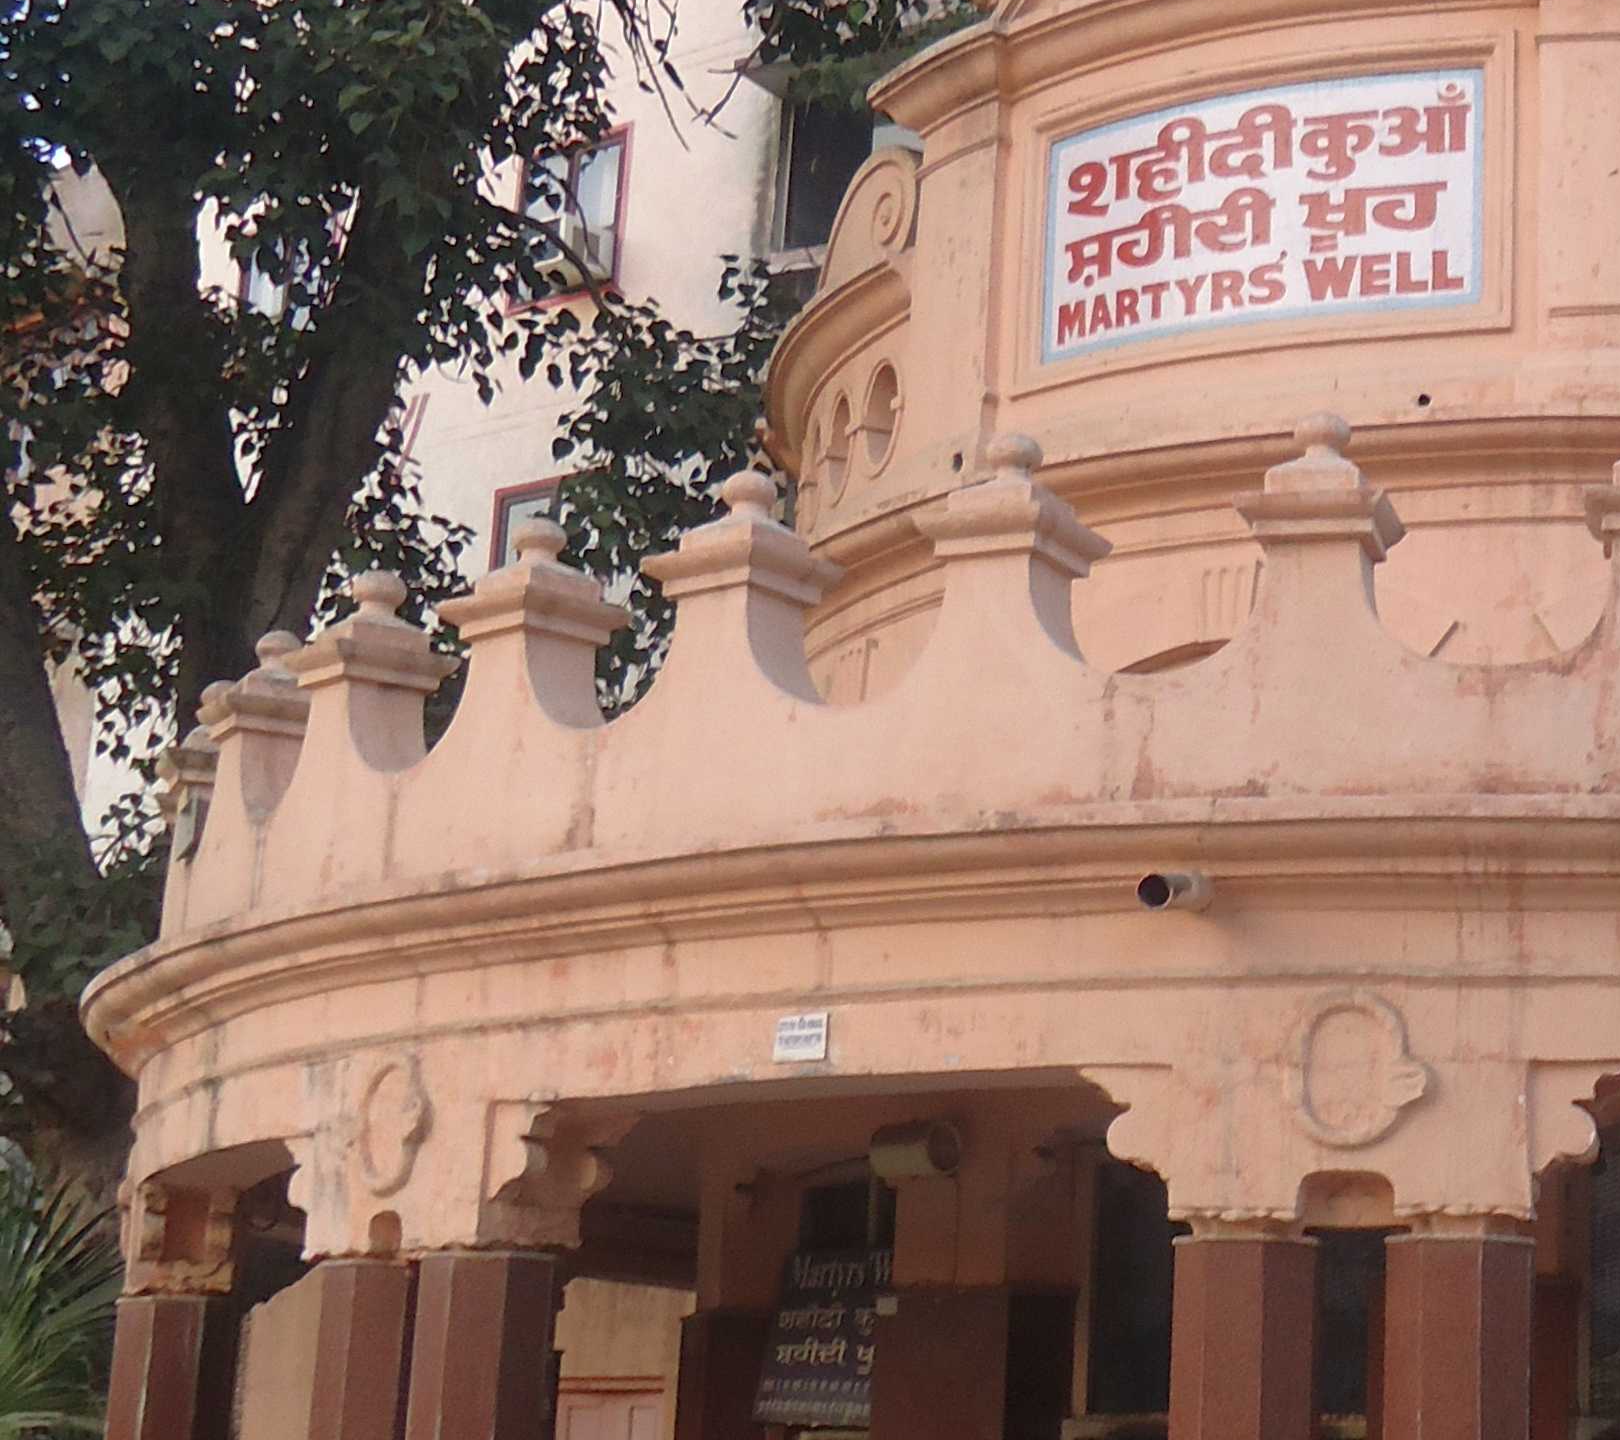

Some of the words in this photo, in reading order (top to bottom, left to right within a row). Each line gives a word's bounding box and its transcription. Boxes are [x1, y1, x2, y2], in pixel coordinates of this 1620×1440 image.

[1067, 103, 1297, 218] शहीदी
[1064, 186, 1276, 288] ਸ਼ਹੀਦੀ
[1299, 181, 1448, 253] ਖੂਹ
[1302, 249, 1465, 302] WELL
